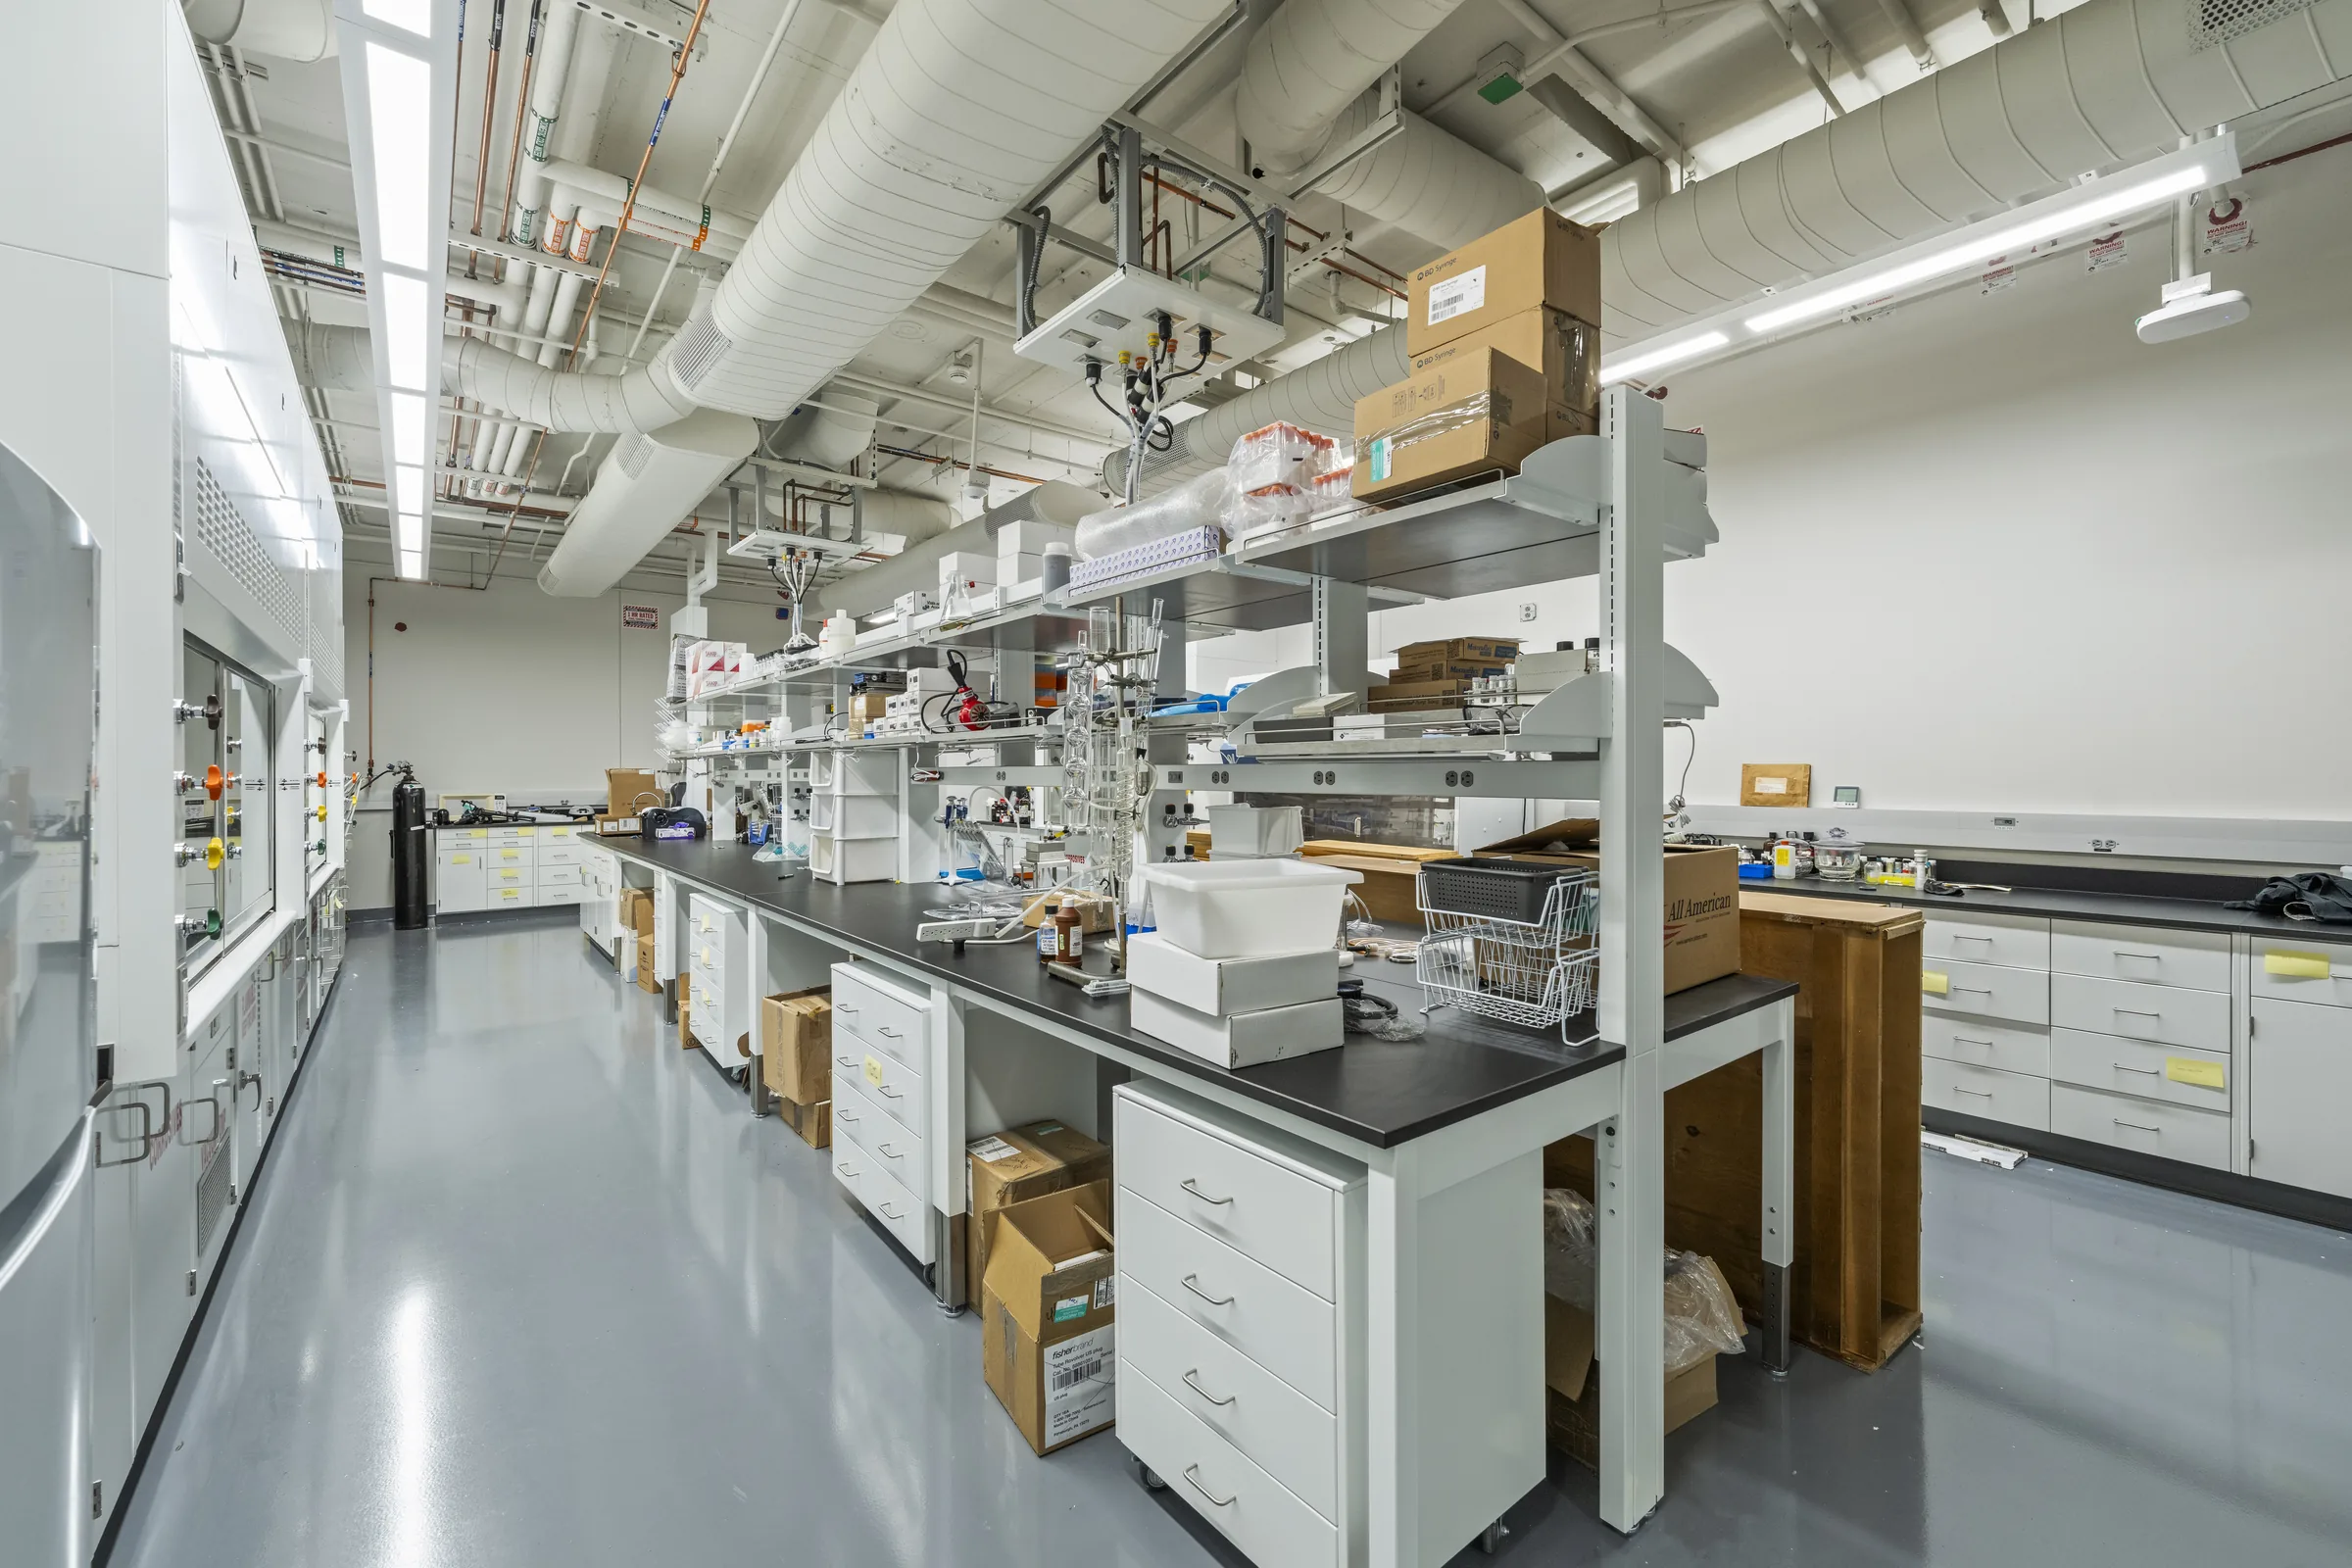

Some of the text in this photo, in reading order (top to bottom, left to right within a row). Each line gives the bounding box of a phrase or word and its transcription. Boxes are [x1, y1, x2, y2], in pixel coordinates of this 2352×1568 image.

[2207, 220, 2247, 234] WARNING!
[2089, 240, 2124, 254] WARNING!
[1425, 257, 1457, 277] BD Syringe
[1424, 347, 1456, 365] BD Syringe
[1667, 899, 1684, 922] All
[1684, 892, 1730, 918] American
[1053, 1337, 1094, 1360] fisherbrand
[1065, 1354, 1084, 1364] Revolver
